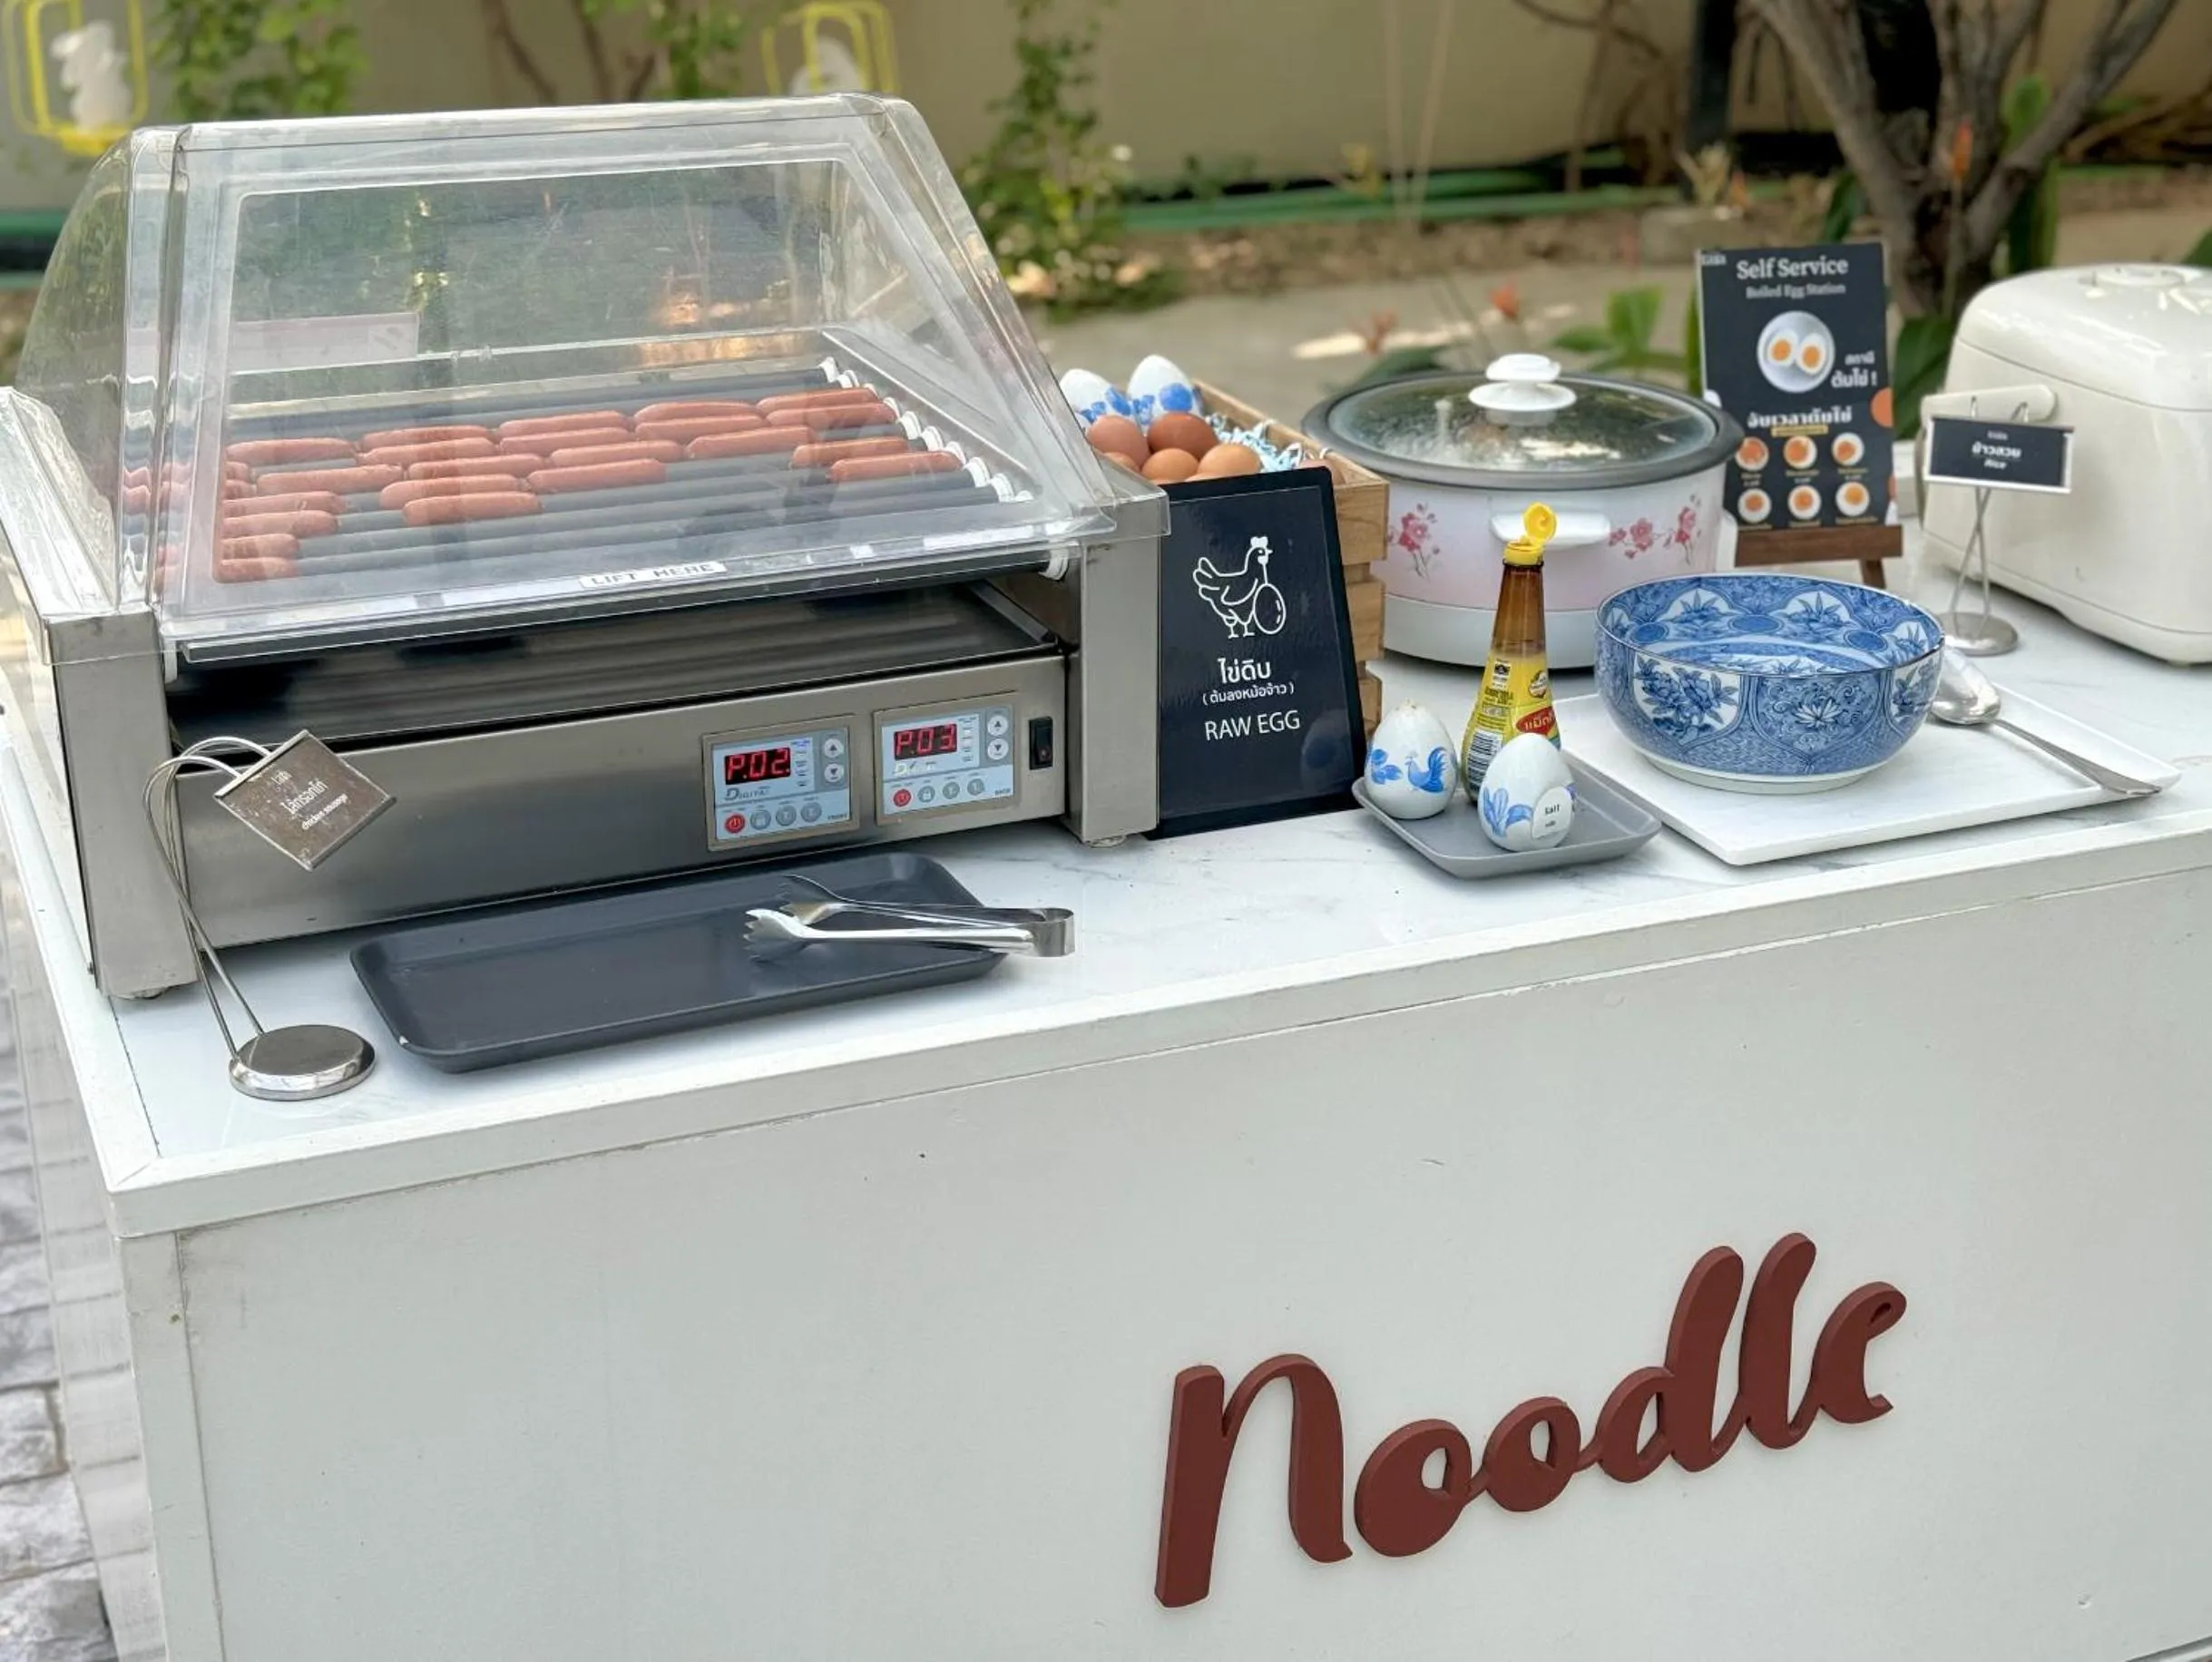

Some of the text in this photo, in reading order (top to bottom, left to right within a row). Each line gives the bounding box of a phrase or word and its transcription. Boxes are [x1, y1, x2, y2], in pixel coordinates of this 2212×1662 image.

[1737, 257, 1776, 279] Self
[1777, 255, 1849, 277] Service
[592, 572, 636, 586] LIFT
[1217, 657, 1272, 684] ไข่ดิบ
[1204, 709, 1301, 741] RAW EGG
